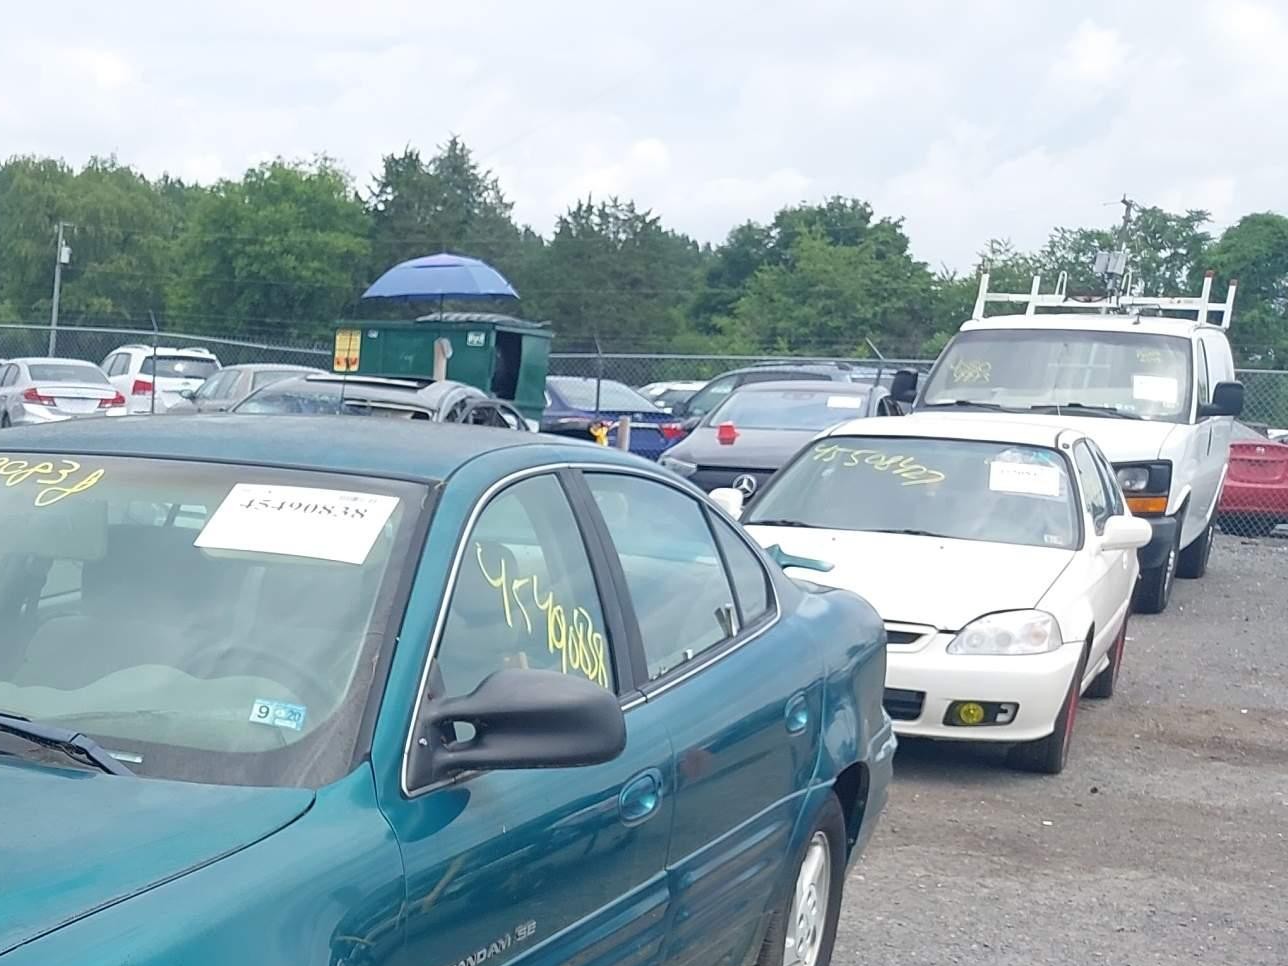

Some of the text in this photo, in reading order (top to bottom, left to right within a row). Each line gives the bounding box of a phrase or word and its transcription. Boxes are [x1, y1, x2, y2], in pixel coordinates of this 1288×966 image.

[239, 498, 369, 521] 45490838
[257, 704, 270, 719] 9
[515, 919, 537, 941] SE
